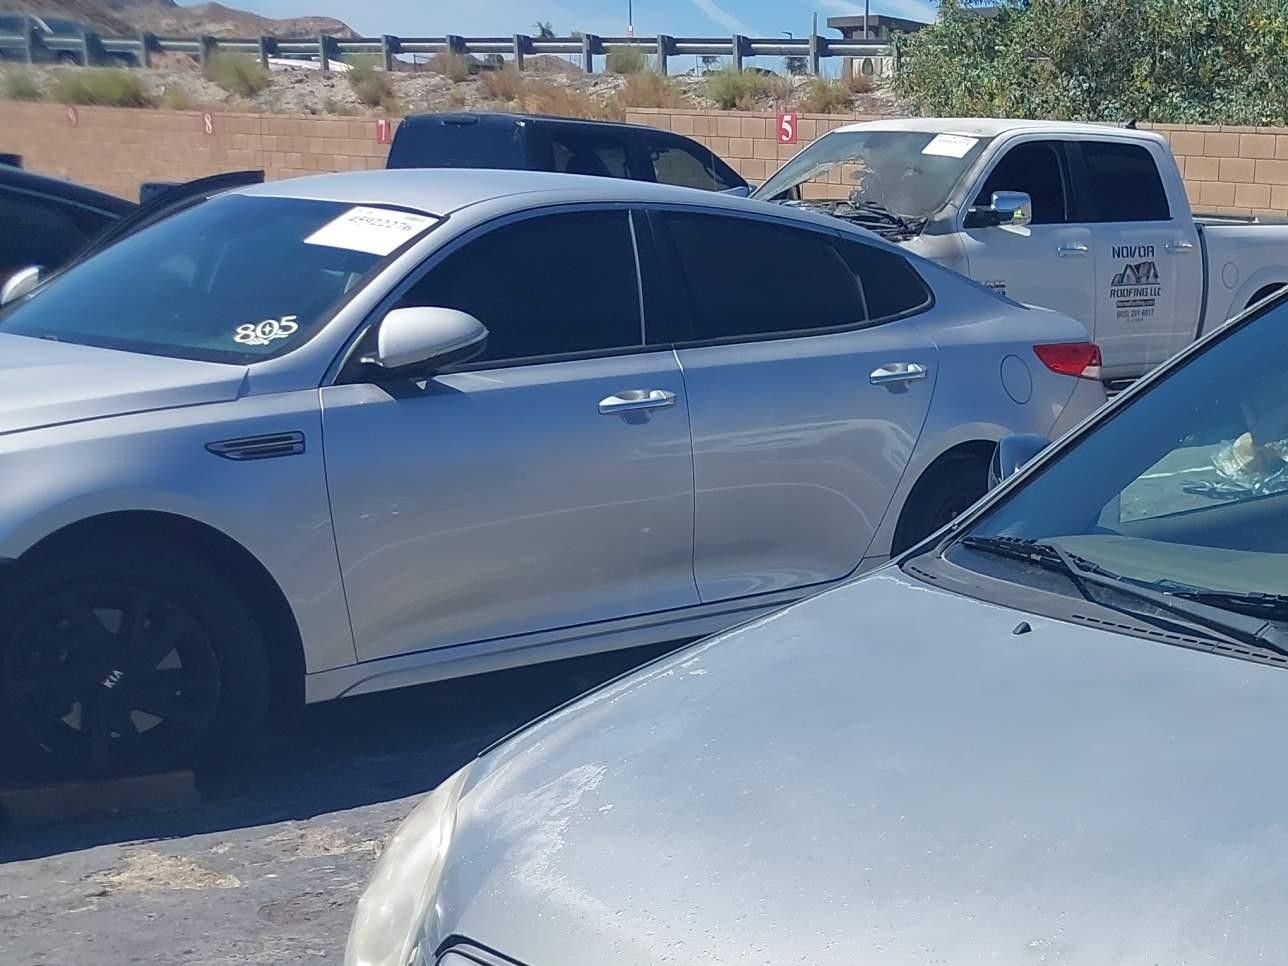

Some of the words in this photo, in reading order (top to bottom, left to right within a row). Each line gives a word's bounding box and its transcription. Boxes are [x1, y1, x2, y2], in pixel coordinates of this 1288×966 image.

[203, 112, 213, 134] 8
[378, 119, 386, 142] 7
[781, 115, 793, 141] 5
[1109, 288, 1148, 299] ROOFING
[1149, 287, 1162, 297] LLC
[233, 315, 299, 344] 805
[102, 670, 125, 689] KIA
